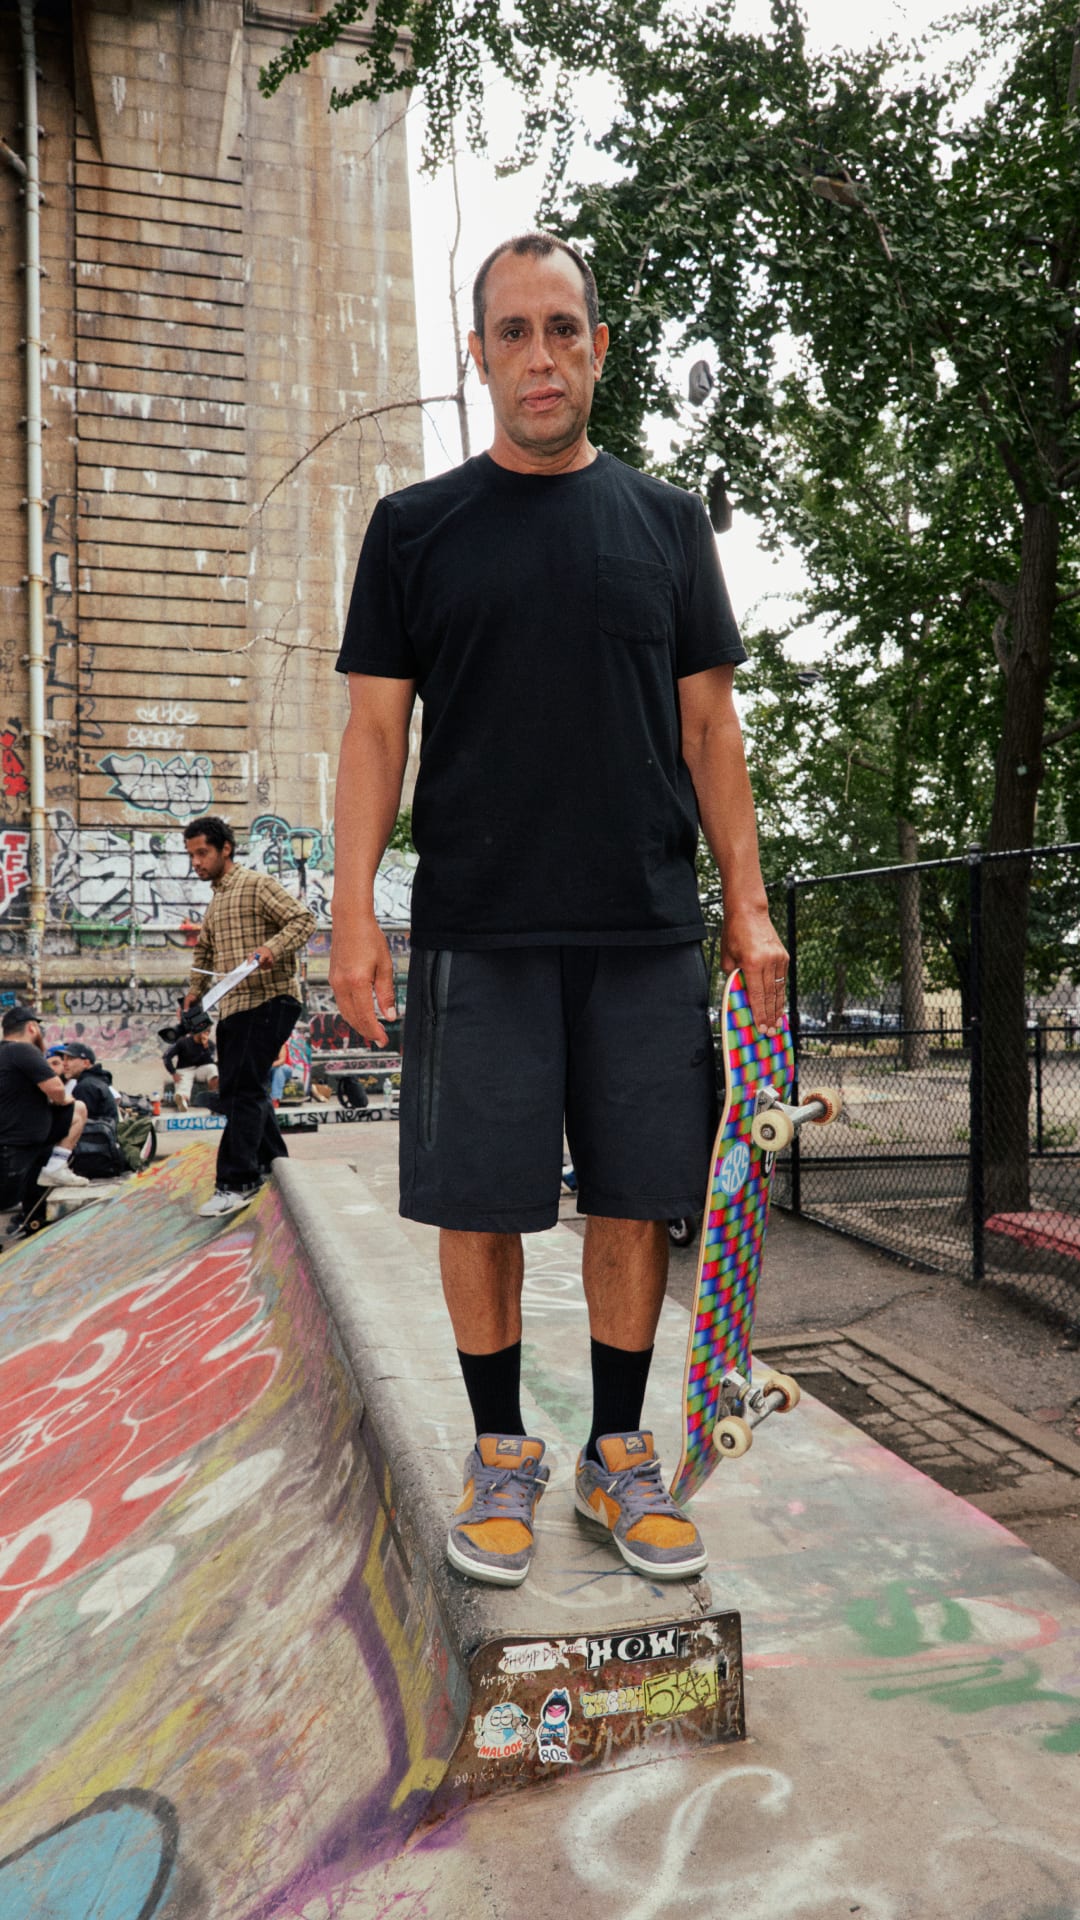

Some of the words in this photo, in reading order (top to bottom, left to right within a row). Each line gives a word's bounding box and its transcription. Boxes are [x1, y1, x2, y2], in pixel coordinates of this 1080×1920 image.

[588, 1629, 676, 1668] HOW
[479, 1740, 523, 1758] MALOOF
[541, 1748, 568, 1761] 80s
